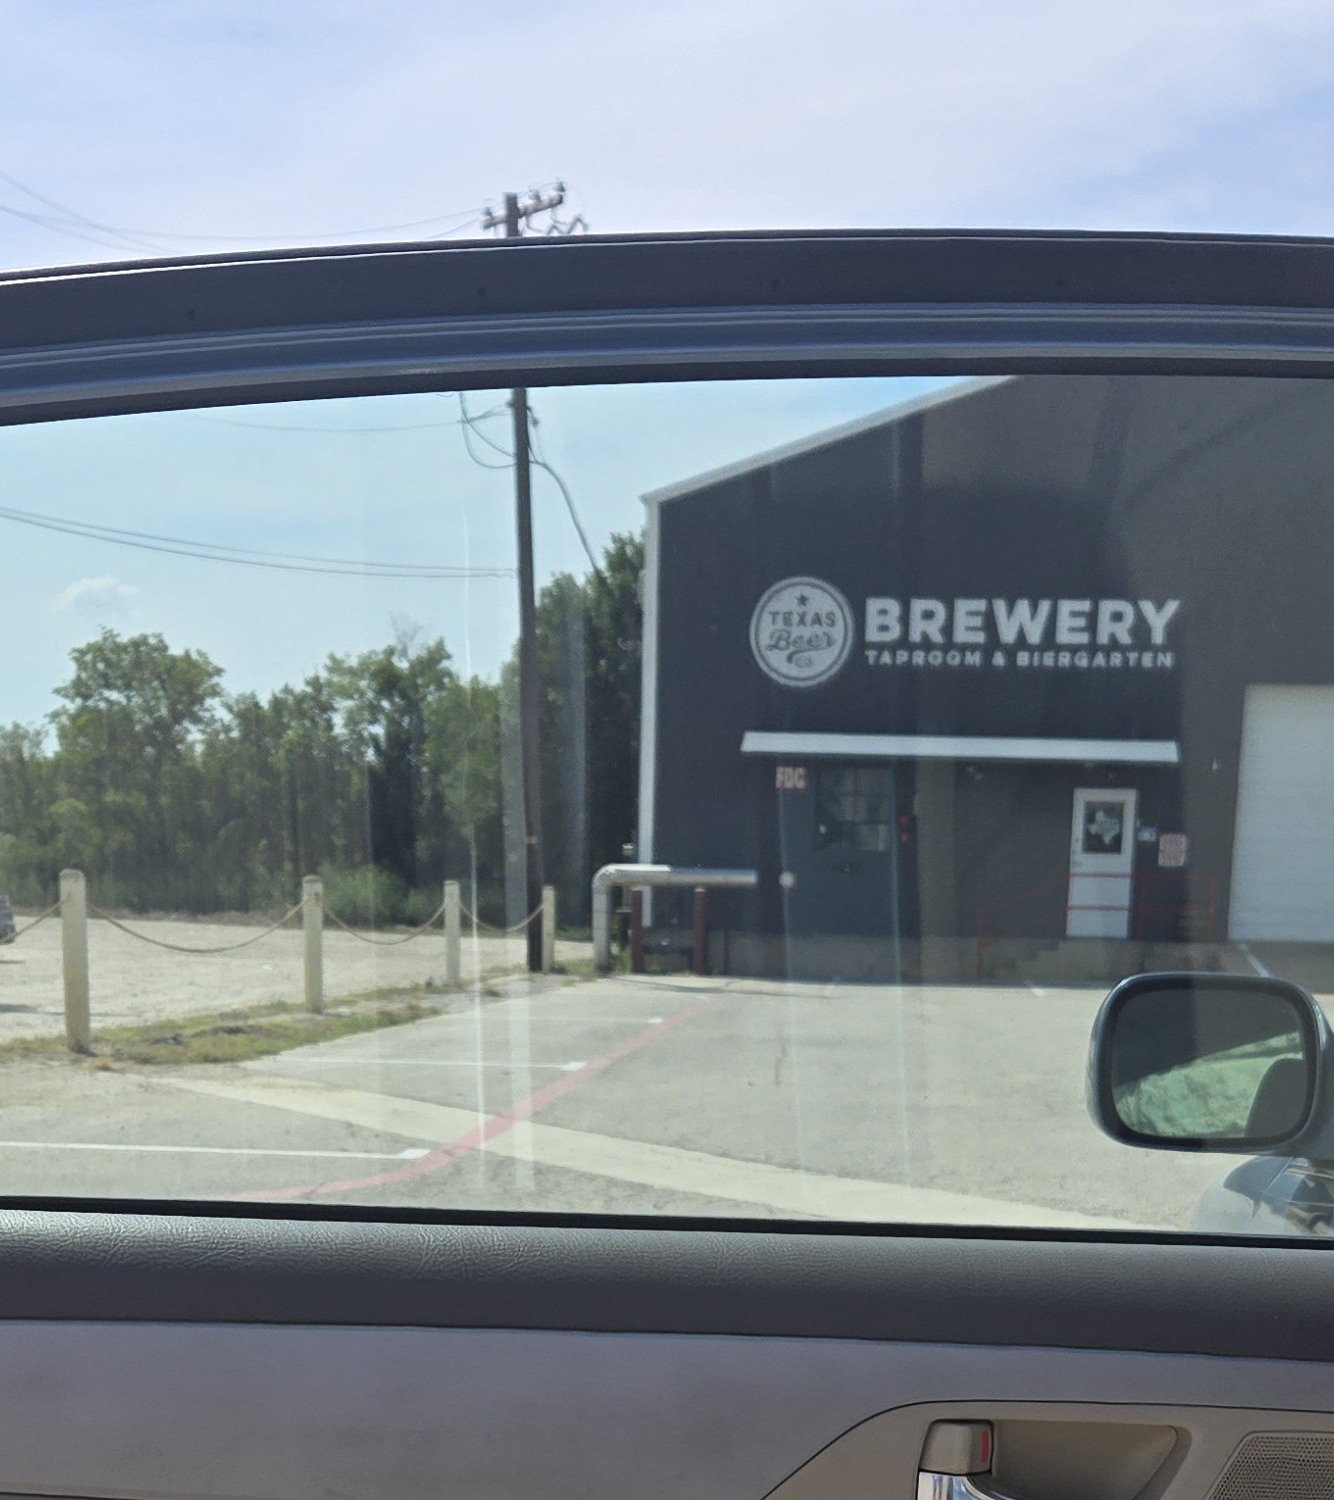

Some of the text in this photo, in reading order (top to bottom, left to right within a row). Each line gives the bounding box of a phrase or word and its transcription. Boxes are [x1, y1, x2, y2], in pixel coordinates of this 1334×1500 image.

[768, 611, 836, 628] TEXAS
[865, 598, 1180, 645] BREWERY
[865, 650, 1174, 667] TAPROOM & BIERGARTEN
